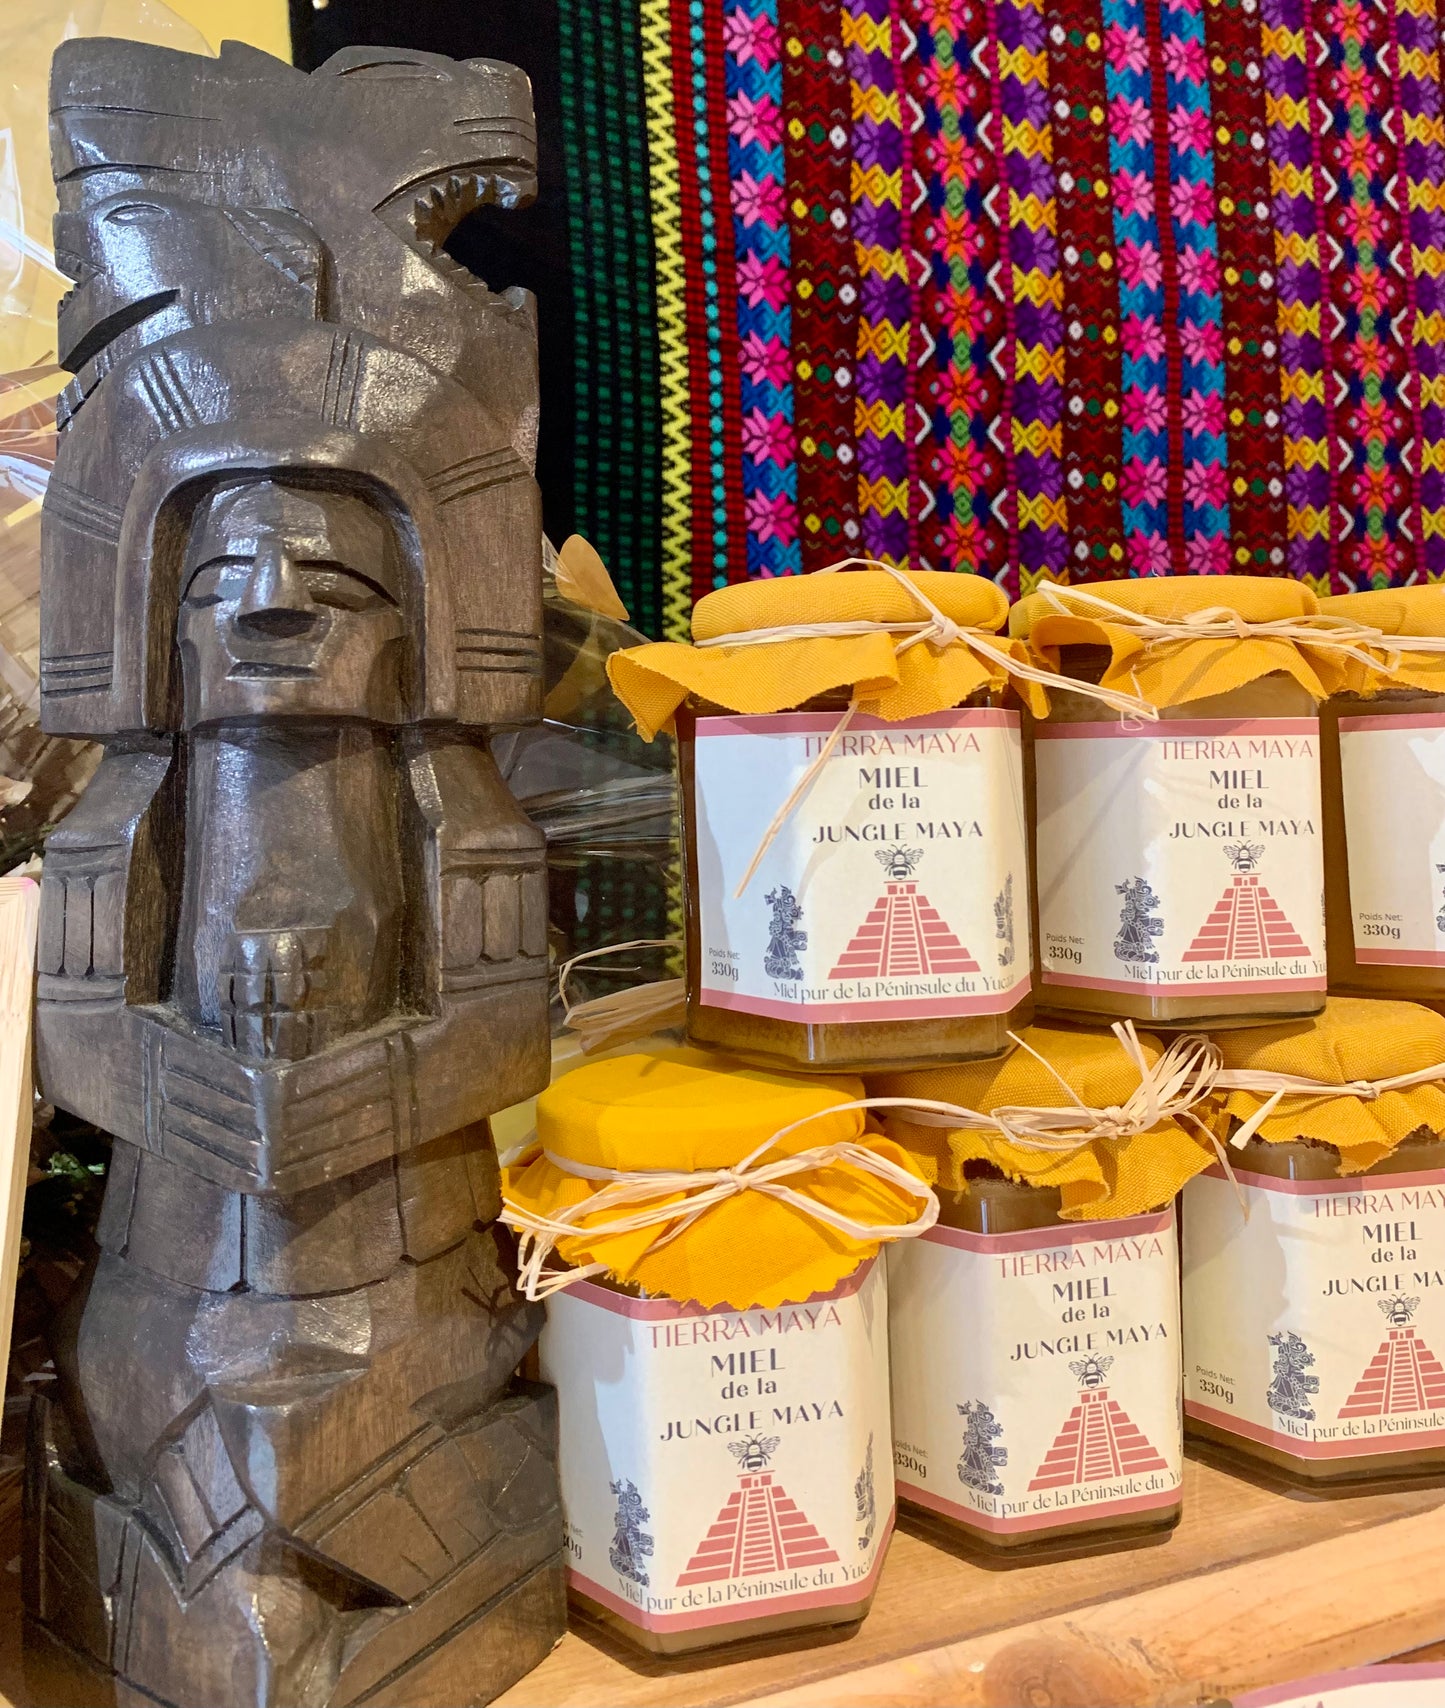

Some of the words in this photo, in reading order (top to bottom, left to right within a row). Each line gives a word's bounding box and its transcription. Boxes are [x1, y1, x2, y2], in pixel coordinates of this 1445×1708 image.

[904, 733, 981, 754] MAYA
[1162, 741, 1241, 760] TIERRA
[1249, 740, 1313, 758] MAYA
[859, 767, 928, 788] MIEL
[1209, 770, 1269, 789] MIEL
[868, 794, 894, 810] de
[902, 793, 920, 809] la
[1218, 795, 1240, 809] de
[1247, 794, 1262, 808] la
[812, 823, 906, 843] JUNGLE
[916, 821, 983, 838] MAYA
[1170, 821, 1249, 838] JUNGLE
[1258, 820, 1314, 836] MAYA
[1359, 913, 1382, 921] Poids
[1046, 933, 1067, 944] Poids
[1363, 924, 1401, 940] 330g
[709, 947, 726, 958] Poids
[1049, 946, 1082, 964] 330g
[711, 962, 739, 981] 330g
[1124, 965, 1152, 980] Miel
[1156, 968, 1183, 984] pur
[1186, 965, 1204, 979] de
[1206, 964, 1219, 979] la
[1222, 960, 1287, 978] Péninsule
[1289, 960, 1307, 974] du
[774, 982, 797, 1000] Miel
[801, 986, 828, 1004] pur
[834, 982, 853, 999] de
[856, 981, 871, 998] la
[875, 975, 951, 997] Péninsule
[955, 974, 975, 992] du
[1311, 1193, 1394, 1218] TIERRA
[1362, 1222, 1423, 1244] MIEL
[997, 1249, 1086, 1278] TIERRA
[1093, 1238, 1164, 1266] MAYA
[1371, 1248, 1394, 1263] de
[1400, 1246, 1417, 1261] la
[1052, 1276, 1117, 1304] MIEL
[1322, 1274, 1406, 1296] JUNGLE
[1413, 1271, 1445, 1290] MA
[1062, 1306, 1086, 1323] de
[1093, 1304, 1110, 1319] la
[647, 1317, 750, 1349] TIERRA
[759, 1305, 842, 1337] MAYA
[1010, 1332, 1099, 1361] JUNGLE
[1106, 1323, 1168, 1346] MAYA
[711, 1348, 786, 1378] MIEL
[1196, 1365, 1218, 1380] Poids
[721, 1380, 749, 1400] de
[758, 1377, 777, 1395] la
[1199, 1379, 1234, 1404] 330g
[660, 1410, 763, 1441] JUNGLE
[772, 1400, 844, 1426] MAYA
[1278, 1416, 1308, 1438] Miel
[1313, 1423, 1339, 1442] pur
[1342, 1418, 1360, 1436] de
[1364, 1418, 1376, 1434] la
[1379, 1412, 1444, 1432] Péninsule
[895, 1440, 916, 1451] oids
[969, 1492, 997, 1514] Miel
[1001, 1498, 1029, 1518] pur
[1032, 1492, 1052, 1509] de
[1055, 1491, 1068, 1506] la
[1072, 1478, 1142, 1505] Péninsule
[1145, 1477, 1164, 1493] du
[617, 1578, 643, 1605] Miel
[647, 1592, 677, 1613] pur
[681, 1586, 704, 1607] de
[707, 1586, 723, 1603] la
[726, 1572, 808, 1601] Péninsule
[812, 1570, 834, 1591] du
